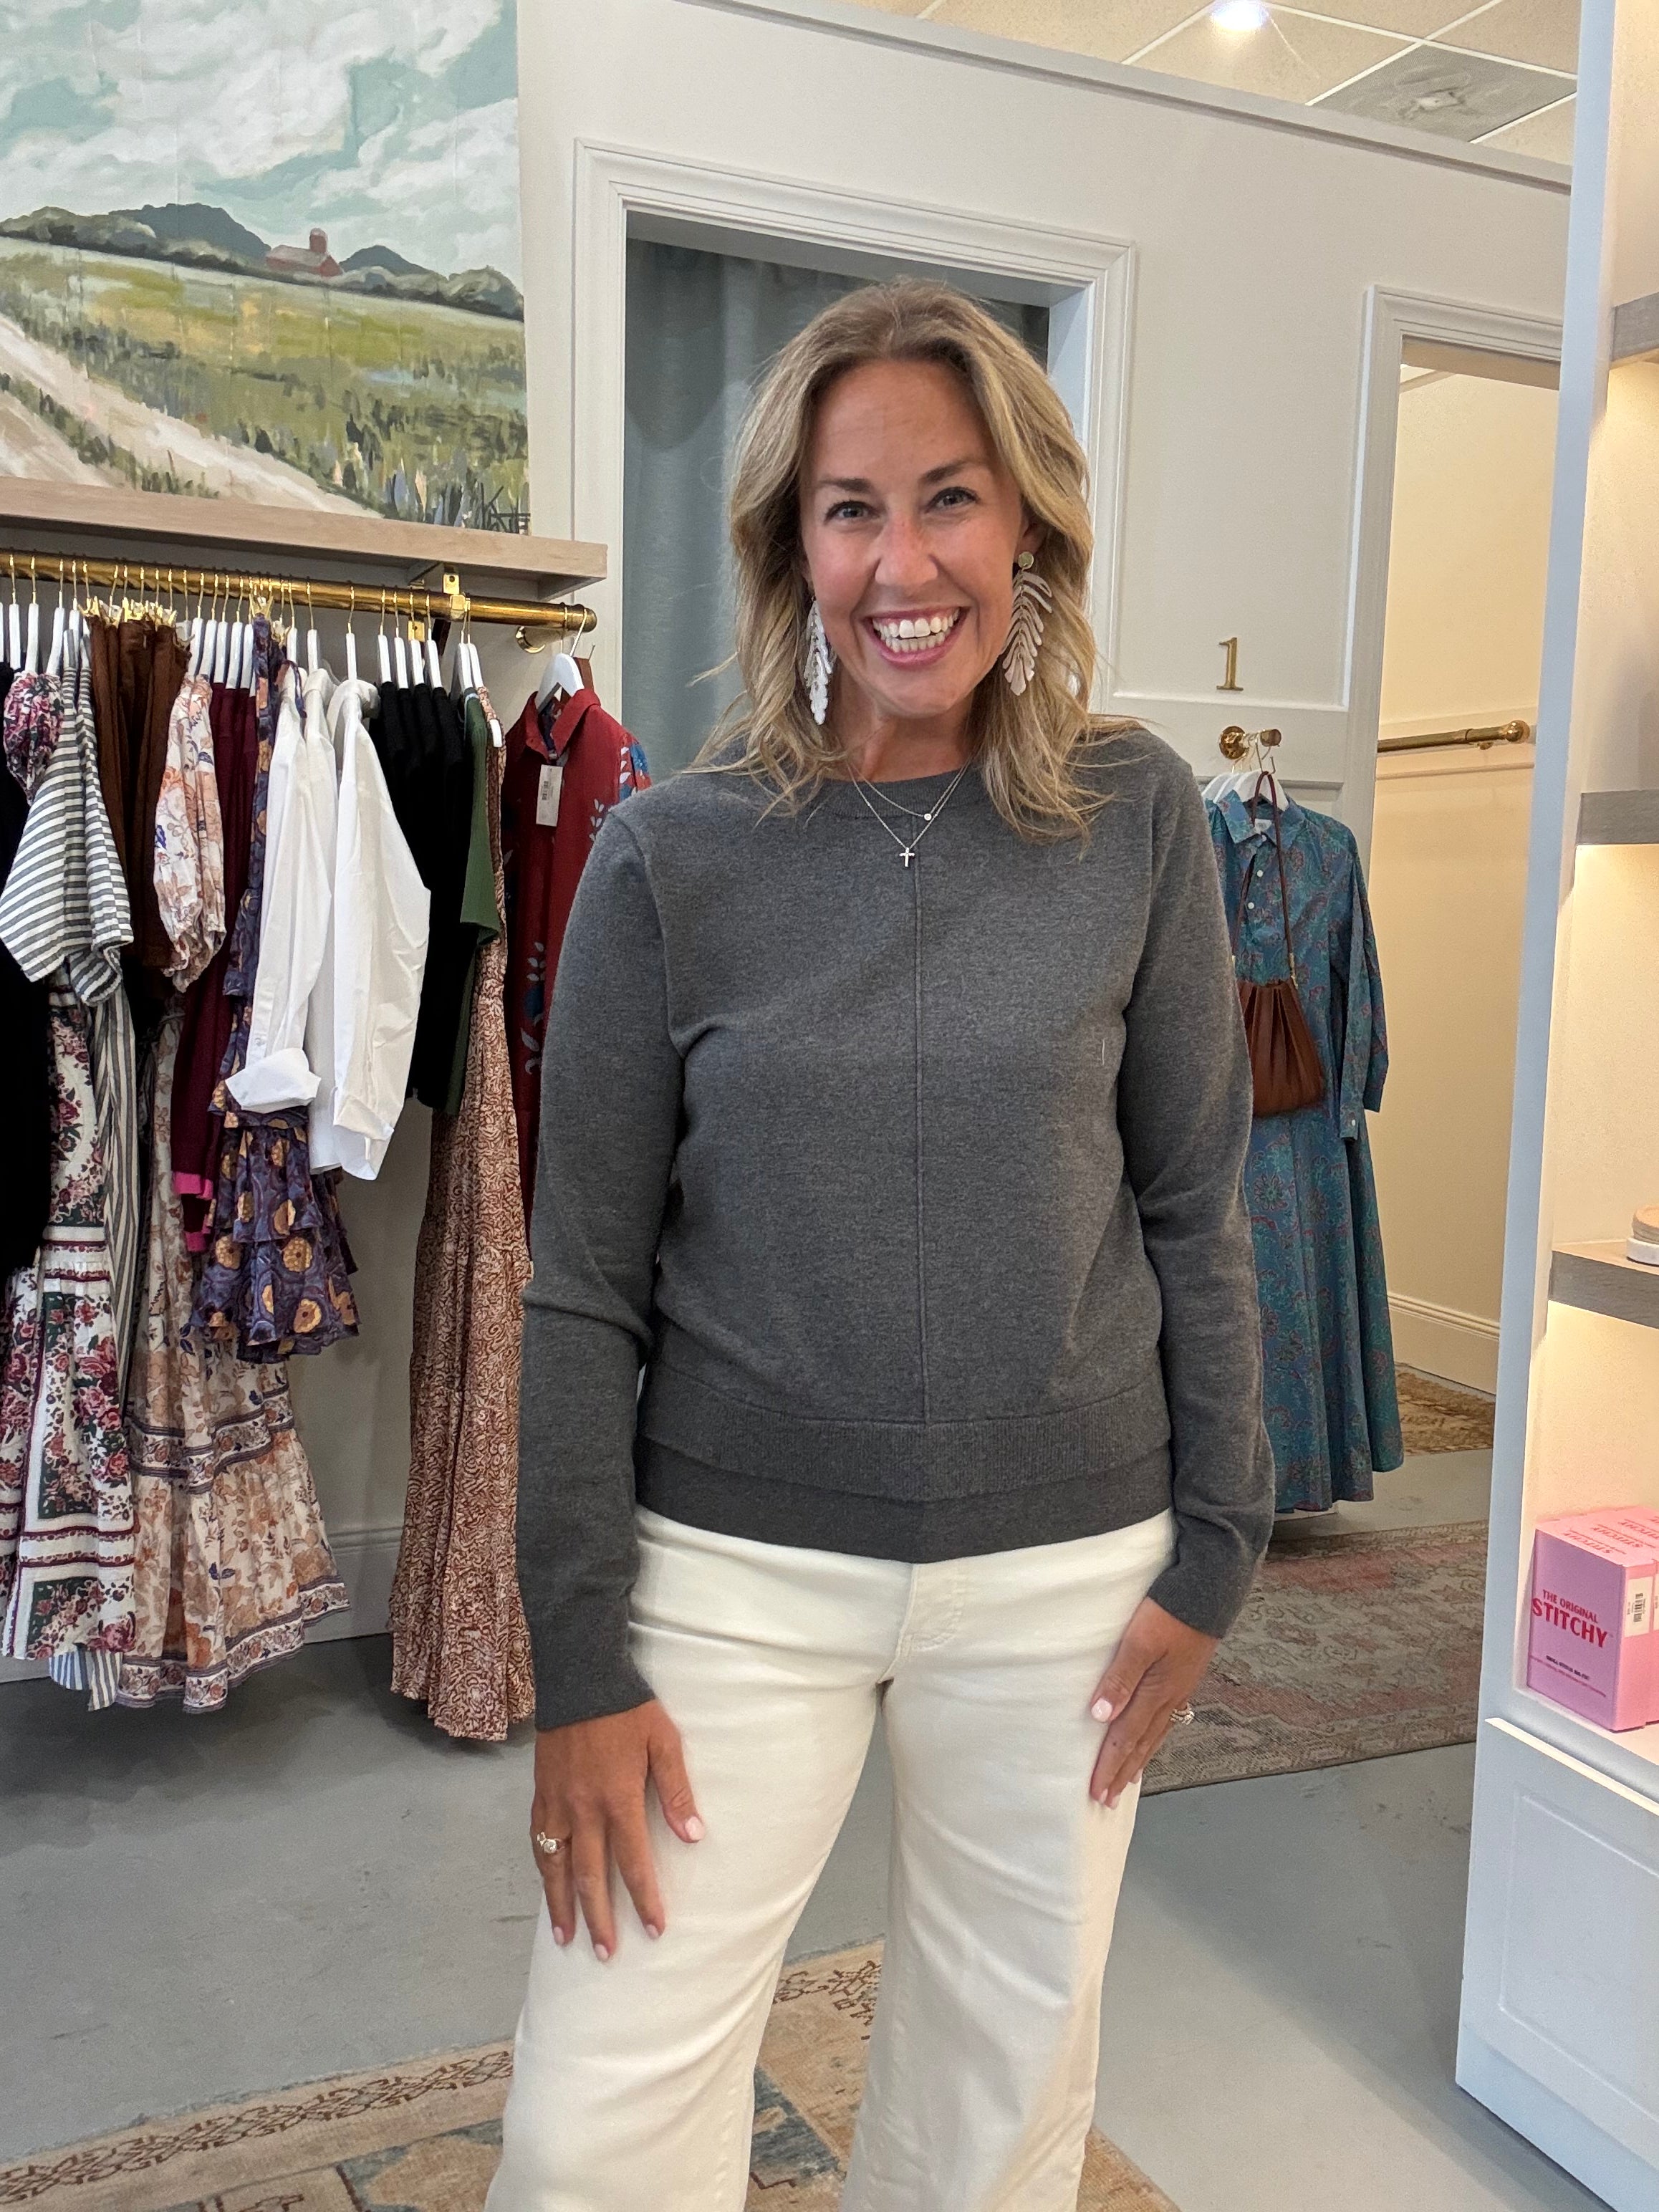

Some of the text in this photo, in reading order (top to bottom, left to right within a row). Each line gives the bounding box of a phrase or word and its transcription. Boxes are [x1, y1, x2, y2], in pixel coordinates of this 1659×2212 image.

[1216, 637, 1244, 691] 1
[1620, 1521, 1659, 1539] TITCHY
[1531, 1597, 1607, 1648] STITCHY
[1542, 1589, 1599, 1624] THE ORIGINAL
